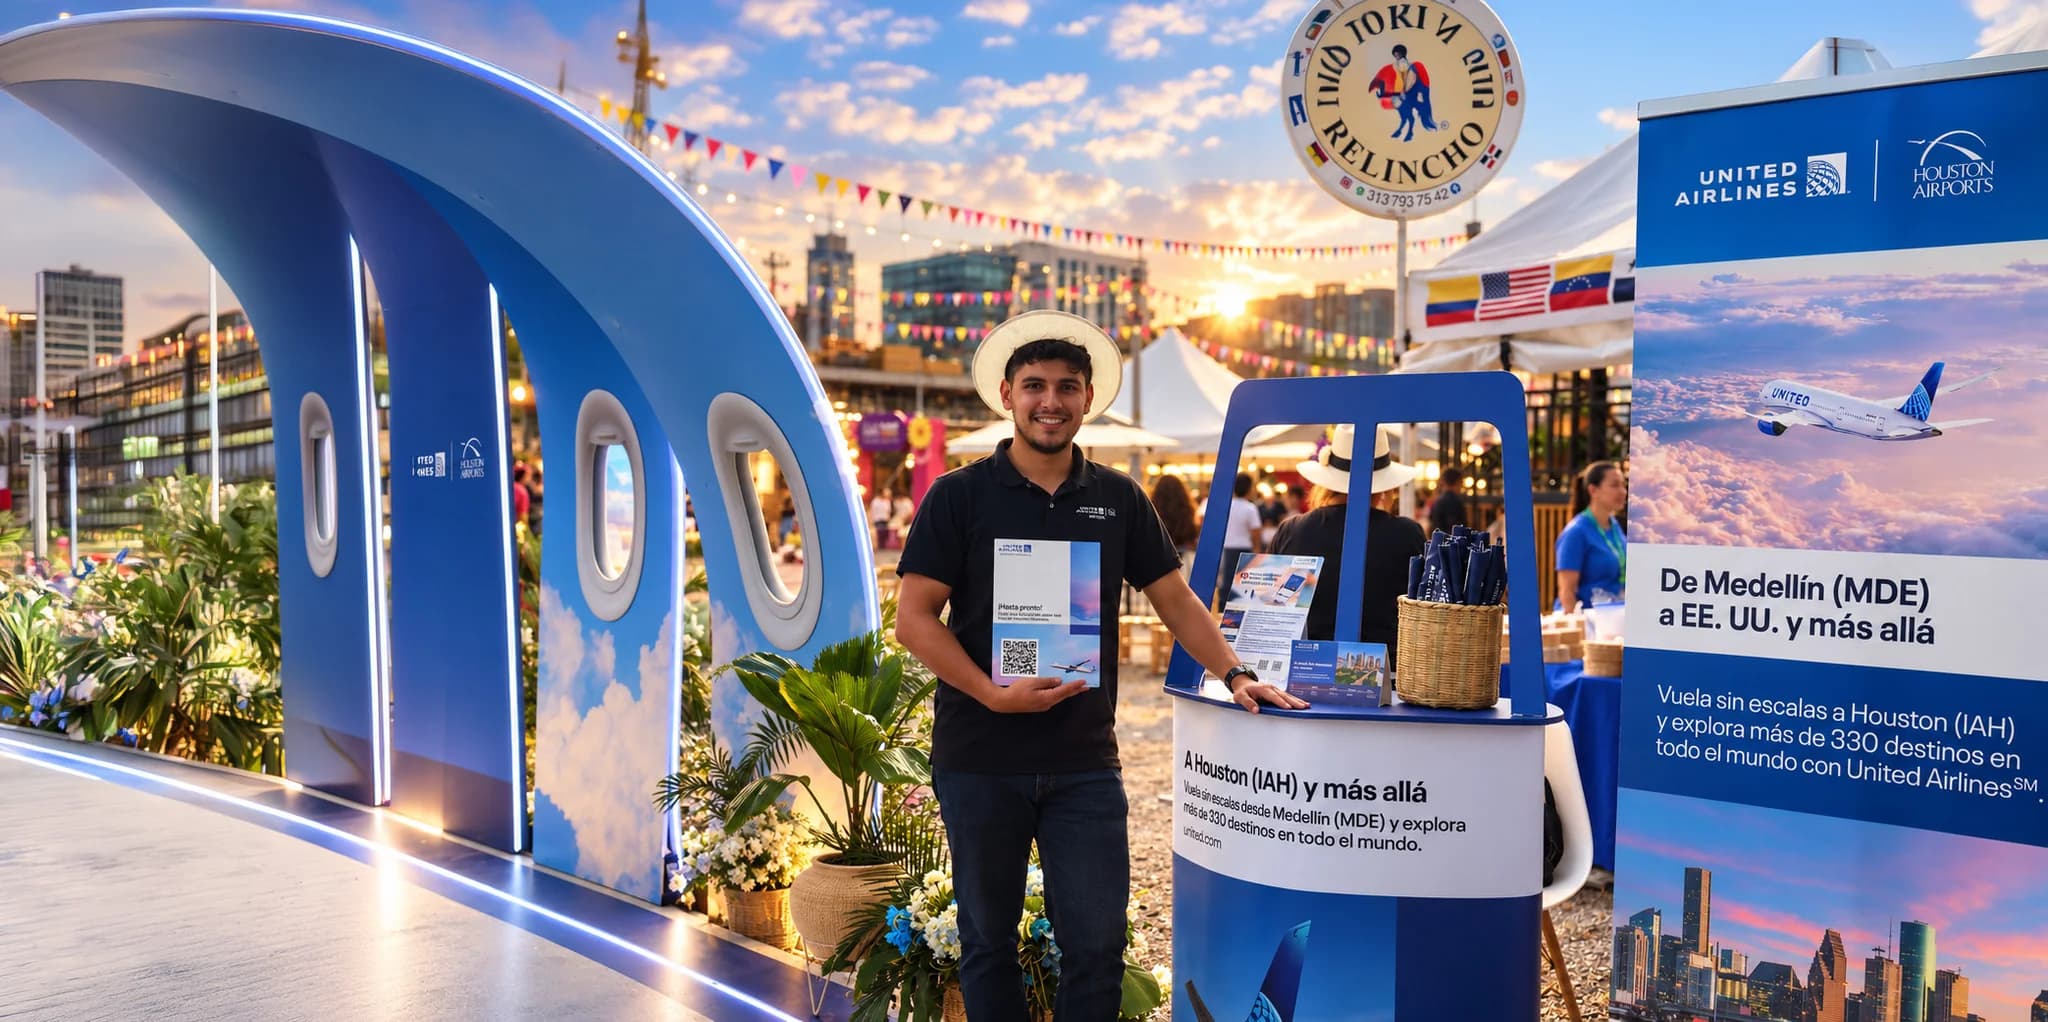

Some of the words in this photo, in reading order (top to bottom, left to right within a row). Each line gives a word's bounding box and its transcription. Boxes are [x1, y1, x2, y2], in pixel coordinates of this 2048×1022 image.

[1322, 116, 1484, 184] RELINCHO
[1913, 160, 1994, 183] HOUSTON
[1674, 181, 1797, 207] AIRLINES
[1699, 161, 1797, 185] UNITED
[1912, 178, 1993, 199] AIRPORTS
[1416, 193, 1432, 206] 75
[1772, 387, 1810, 407] UNITED
[1660, 567, 1698, 594] De
[1704, 570, 1824, 601] Medellín
[1833, 574, 1930, 613] (MDE)
[1659, 608, 1675, 627] a
[1681, 603, 1721, 630] EE.
[1729, 605, 1779, 634] UU.
[1786, 617, 1803, 641] y
[1809, 613, 1873, 641] más
[1879, 617, 1936, 645] allá
[1657, 684, 1711, 708] Vuela
[1716, 690, 1744, 711] sin
[1749, 696, 1828, 721] escalas
[1832, 707, 1845, 723] a
[1851, 703, 1948, 733] Houston
[1954, 711, 2016, 745] (IAH)
[1655, 737, 1701, 760] todo
[1704, 743, 1721, 762] el
[1726, 745, 1798, 773] mundo
[1801, 756, 1842, 777] con
[1847, 759, 1921, 787] United
[1656, 716, 1667, 734] y
[1671, 717, 1745, 739] explora
[1750, 722, 1794, 745] más
[1798, 726, 1826, 748] de
[1830, 729, 1879, 753] 330
[1884, 733, 1984, 766] destinos
[1990, 750, 2021, 770] en
[1184, 750, 1193, 771] A
[1195, 752, 1248, 787] Houston
[1252, 767, 1298, 800] (IAH)
[1303, 781, 1318, 802] y
[1323, 778, 1377, 801] más
[1382, 780, 1427, 803] allá
[1183, 779, 1201, 798] Vuela
[1201, 788, 1211, 802] sin
[1211, 794, 1240, 811] escalas
[1241, 800, 1271, 818] desde
[1273, 806, 1330, 826] Medellín
[1334, 810, 1385, 833] (MDE)
[1389, 819, 1400, 833] y
[1402, 816, 1466, 835] explora
[1183, 801, 1198, 817] más
[1198, 807, 1208, 820] de
[1209, 809, 1226, 827] 330
[1228, 816, 1276, 839] destinos
[1278, 830, 1295, 842] en
[1298, 830, 1335, 847] todo
[1339, 833, 1353, 848] el
[1357, 835, 1422, 852] mundo.
[1183, 826, 1222, 849] united.com
